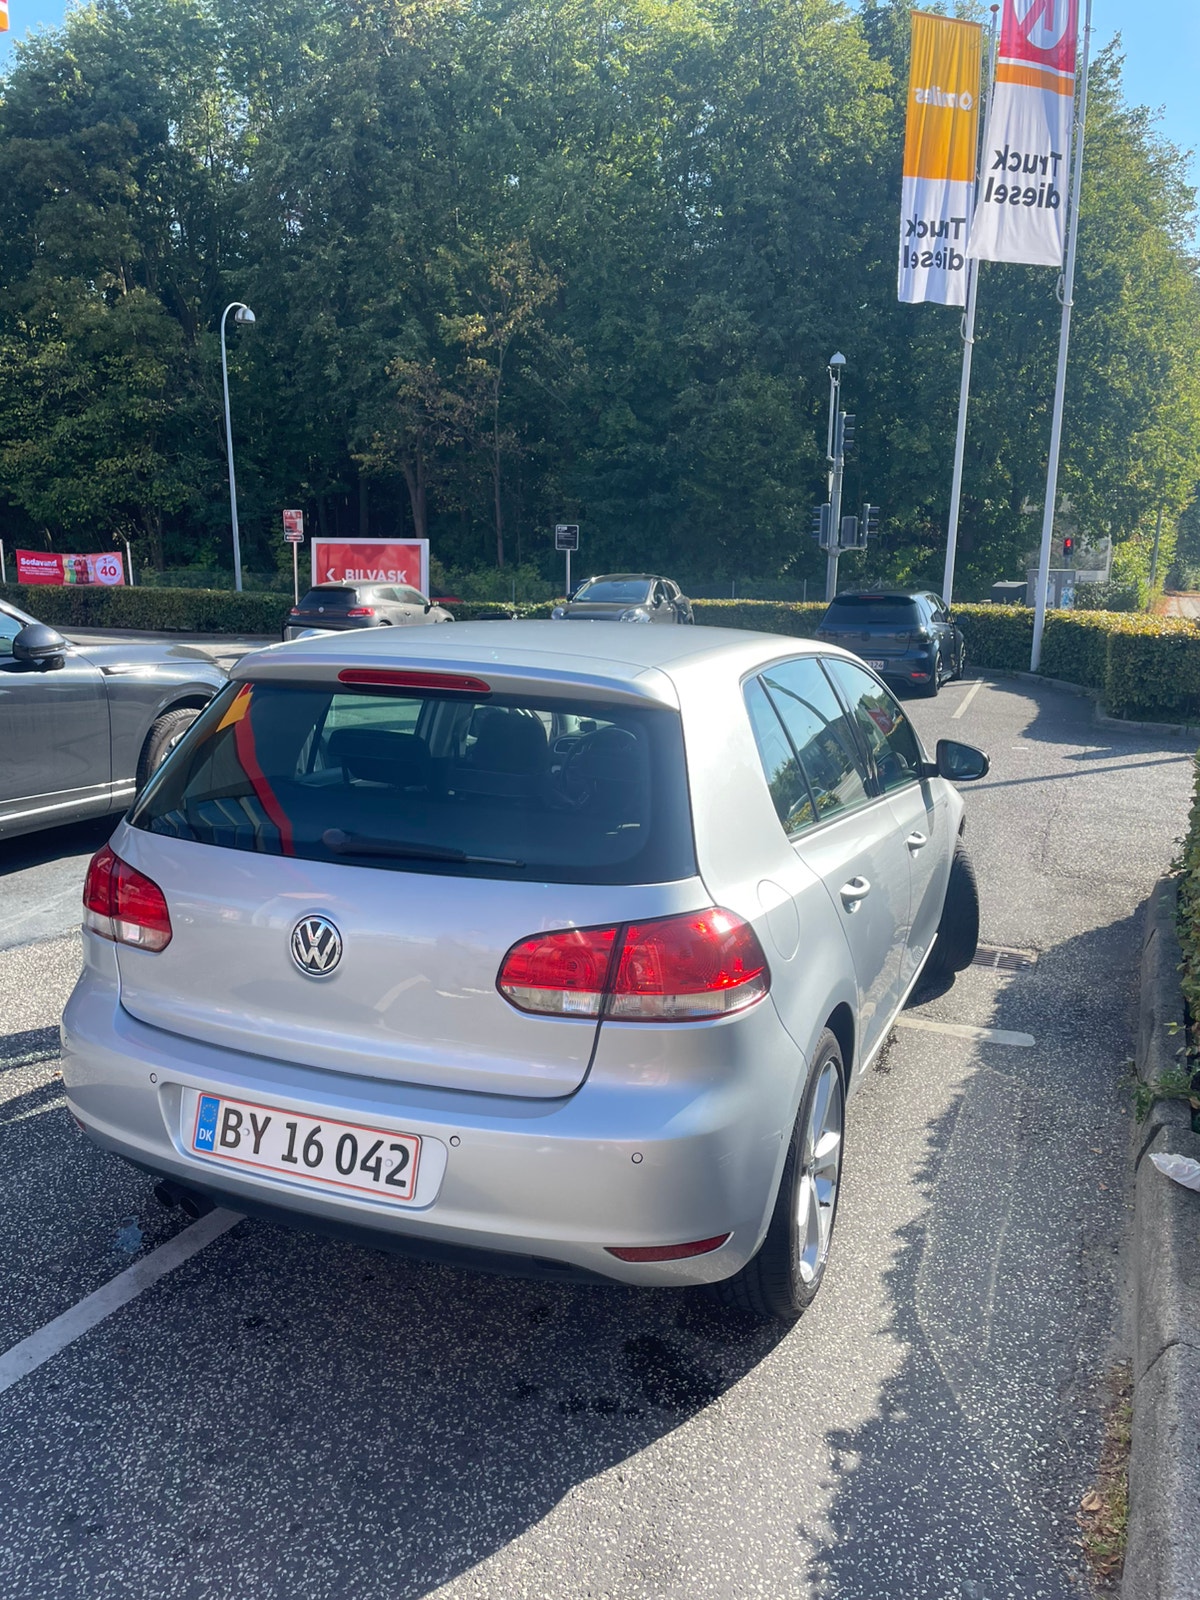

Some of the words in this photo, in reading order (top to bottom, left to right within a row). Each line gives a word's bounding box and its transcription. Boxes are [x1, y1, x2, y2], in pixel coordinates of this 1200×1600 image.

[100, 565, 117, 577] 40
[345, 569, 407, 583] BILVASK
[199, 1128, 212, 1142] DK
[220, 1107, 272, 1155] BY
[281, 1122, 324, 1168] 16
[335, 1133, 410, 1188] 042
